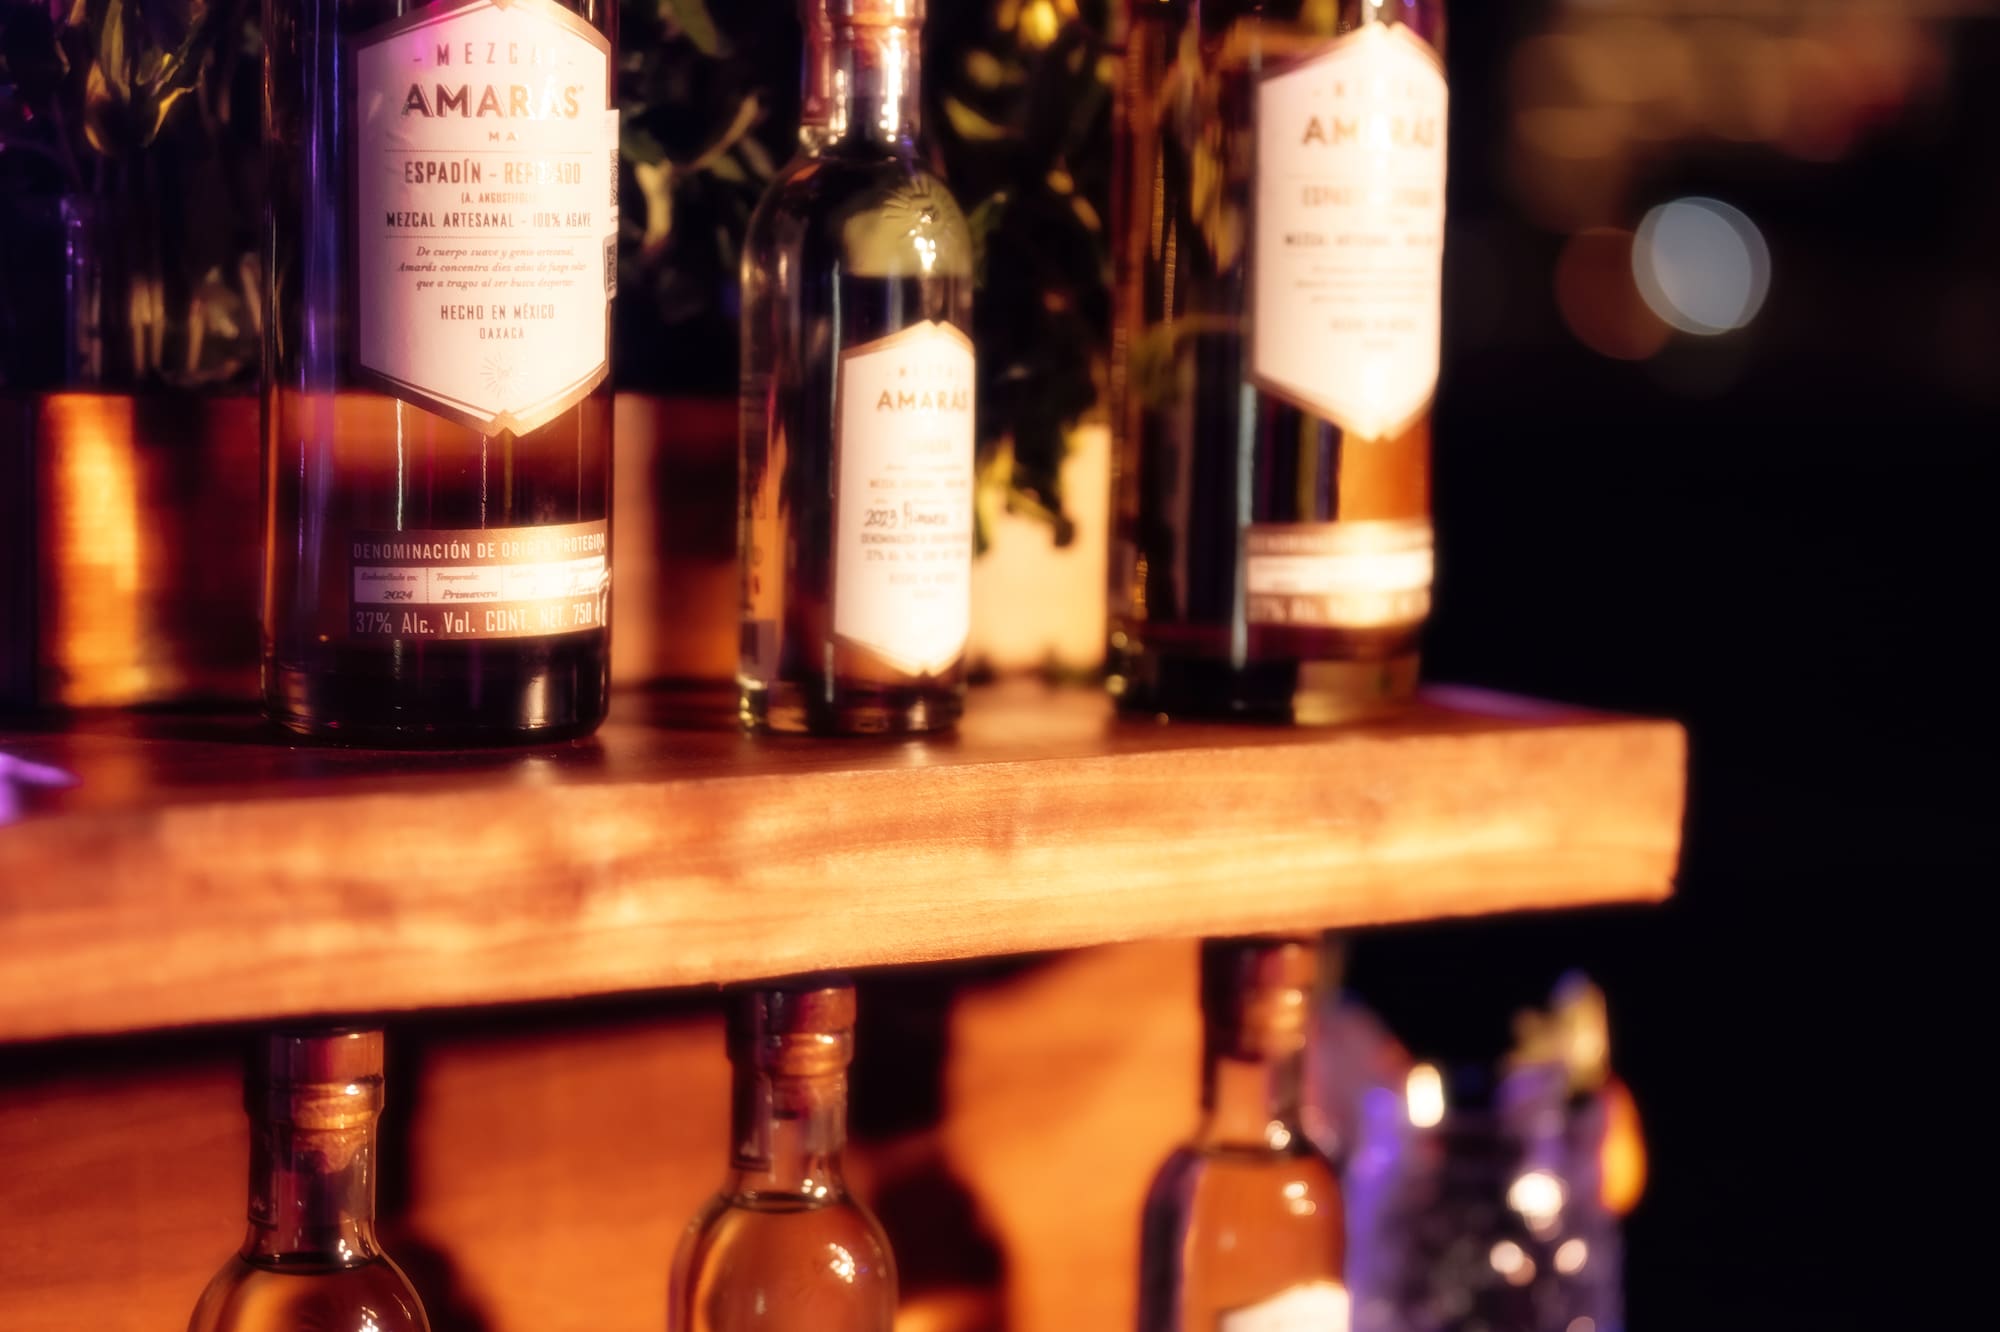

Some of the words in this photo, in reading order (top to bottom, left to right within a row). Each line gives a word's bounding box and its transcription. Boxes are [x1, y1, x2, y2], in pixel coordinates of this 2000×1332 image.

[401, 82, 580, 119] AMARS
[404, 158, 482, 185] ESPADÍN
[385, 212, 436, 228] MEZCAL
[443, 211, 515, 228] ARTESANAL
[532, 212, 561, 228] 100%
[566, 211, 592, 228] AGAVE
[416, 246, 432, 257] De
[433, 248, 468, 259] cuerpo
[470, 248, 499, 257] suave
[500, 248, 508, 259] y
[397, 261, 437, 272] Amarás
[439, 262, 489, 272] concentra
[491, 261, 512, 272] diez
[416, 279, 435, 291] que
[436, 279, 445, 288] a
[446, 278, 478, 290] tragos
[480, 277, 493, 288] al
[440, 304, 484, 320] HECHO
[491, 304, 506, 320] EN
[513, 302, 555, 320] MÉXICO
[479, 327, 525, 339] OAXACA
[353, 539, 471, 560] DENOMINACIÓN
[476, 542, 496, 559] DE
[383, 590, 413, 600] 2024
[356, 611, 392, 634] 37%
[401, 612, 435, 635] Alc.
[443, 611, 476, 634] Vol.
[572, 601, 592, 625] 750
